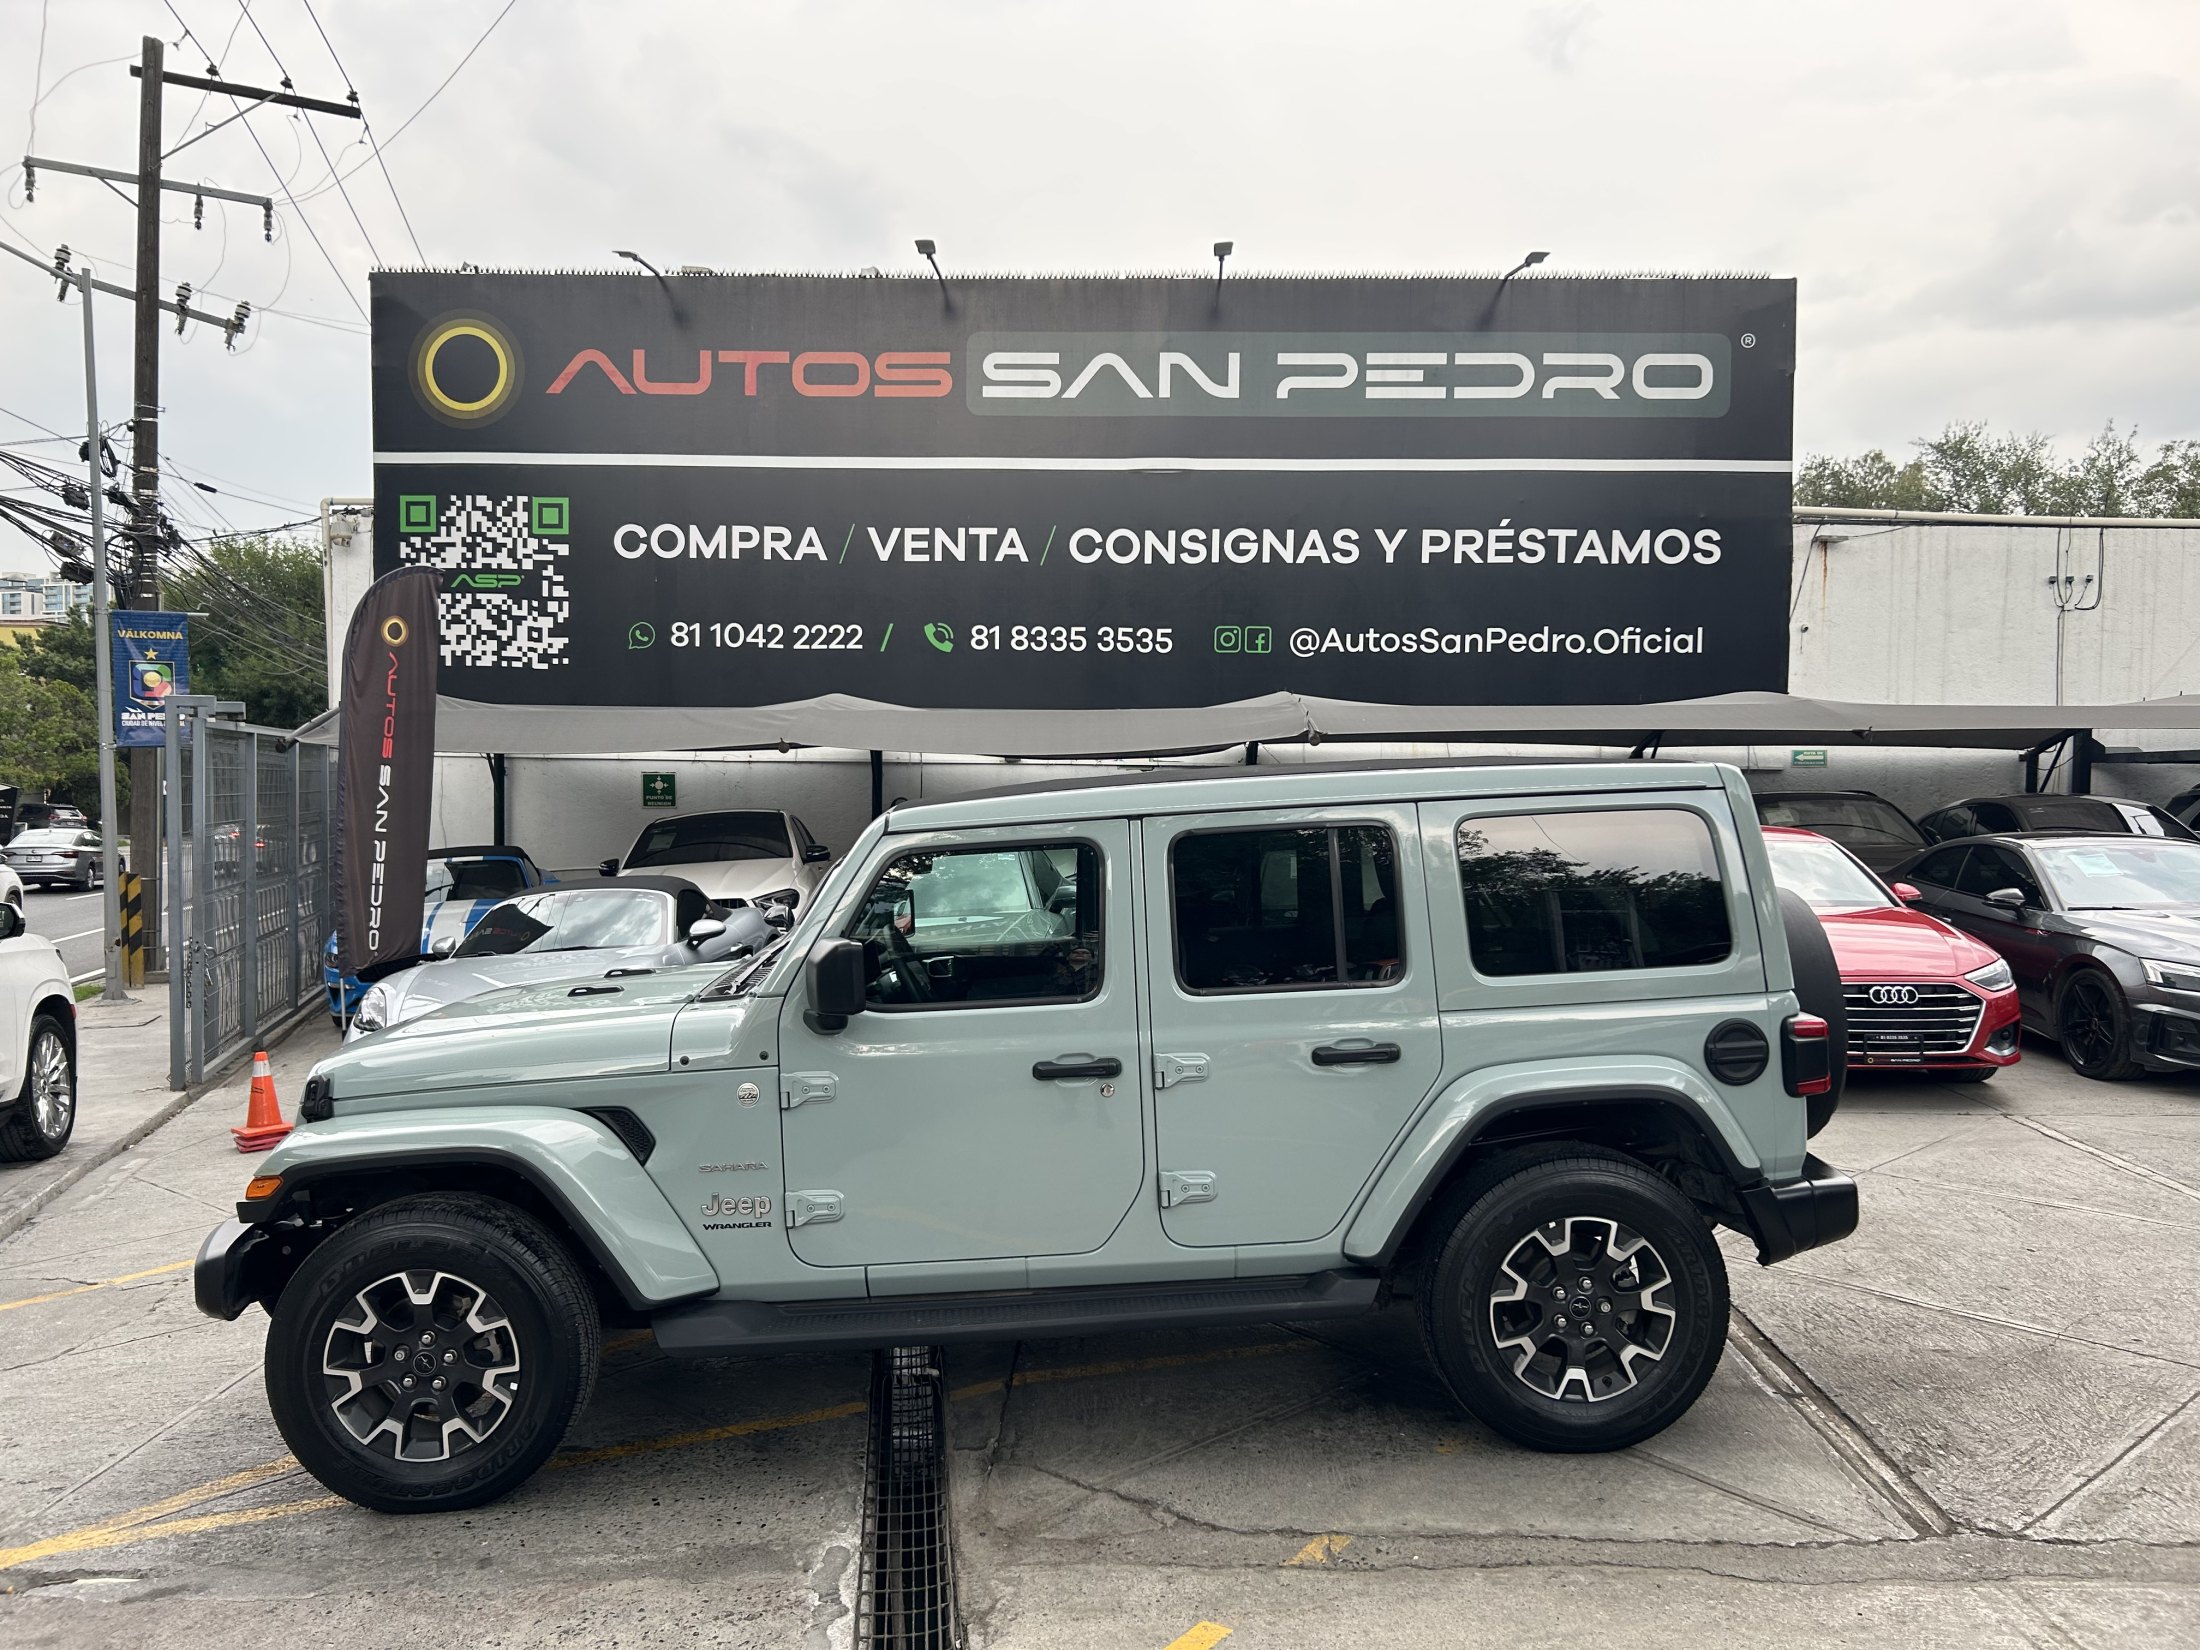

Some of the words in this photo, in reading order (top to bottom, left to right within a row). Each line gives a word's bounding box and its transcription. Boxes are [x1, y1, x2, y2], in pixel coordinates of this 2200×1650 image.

[546, 349, 953, 398] AUTOS
[981, 351, 1241, 400] SAN
[1276, 352, 1714, 400] PEDRO
[613, 523, 829, 561] COMPRA
[867, 526, 1029, 562] VENTA
[1069, 527, 1360, 565] CONSIGNAS
[1374, 528, 1408, 564] Y
[1421, 518, 1722, 565] PRÉSTAMOS
[450, 573, 522, 588] ASP
[118, 628, 183, 640] VÄLKOMNA
[670, 622, 701, 648] 81
[709, 622, 784, 649] 1042
[792, 624, 863, 650] 2222
[970, 624, 1000, 651] 81
[1010, 625, 1087, 652] 8335
[1096, 626, 1173, 654] 3535
[1289, 625, 1703, 657] @AutosSanPedro.Oficial
[380, 651, 399, 760] AUTOS
[374, 763, 392, 834] SAN
[368, 839, 388, 952] PEDRO
[698, 1161, 769, 1173] SAHARA
[701, 1192, 772, 1218] Jeep
[702, 1221, 772, 1231] WRANGLER
